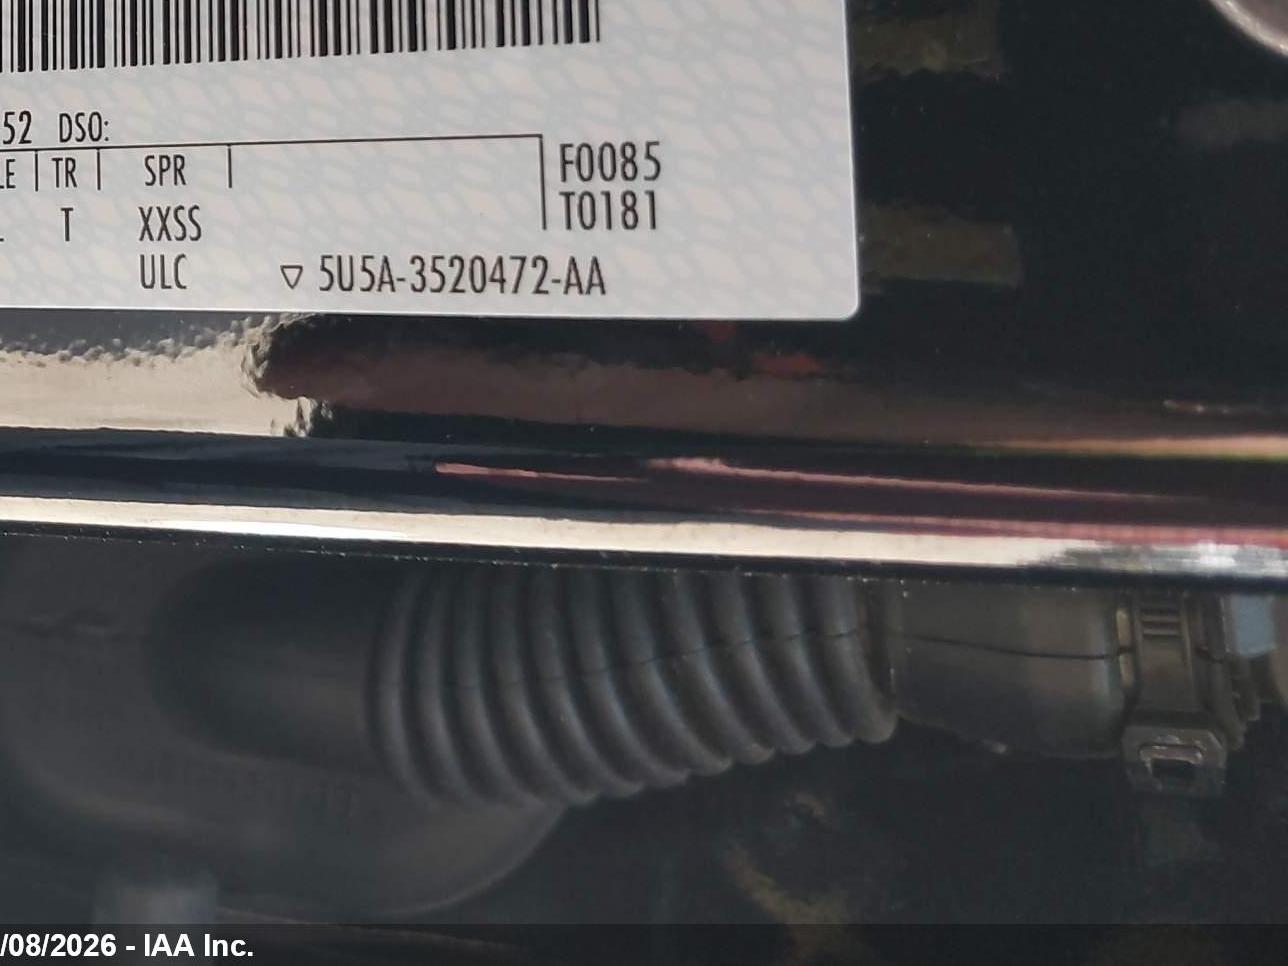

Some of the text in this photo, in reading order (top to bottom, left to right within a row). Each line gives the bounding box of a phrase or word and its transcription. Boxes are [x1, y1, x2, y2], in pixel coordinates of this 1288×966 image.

[2, 109, 33, 146] 52
[58, 111, 110, 144] DSO:
[51, 156, 78, 189] TR
[144, 153, 187, 187] SPR
[559, 140, 662, 183] F0085
[60, 207, 74, 242] T
[138, 204, 202, 242] XXSS
[558, 189, 657, 231] T0181
[139, 253, 188, 290] ULC
[319, 254, 607, 296] 5U5A-3520472-AA
